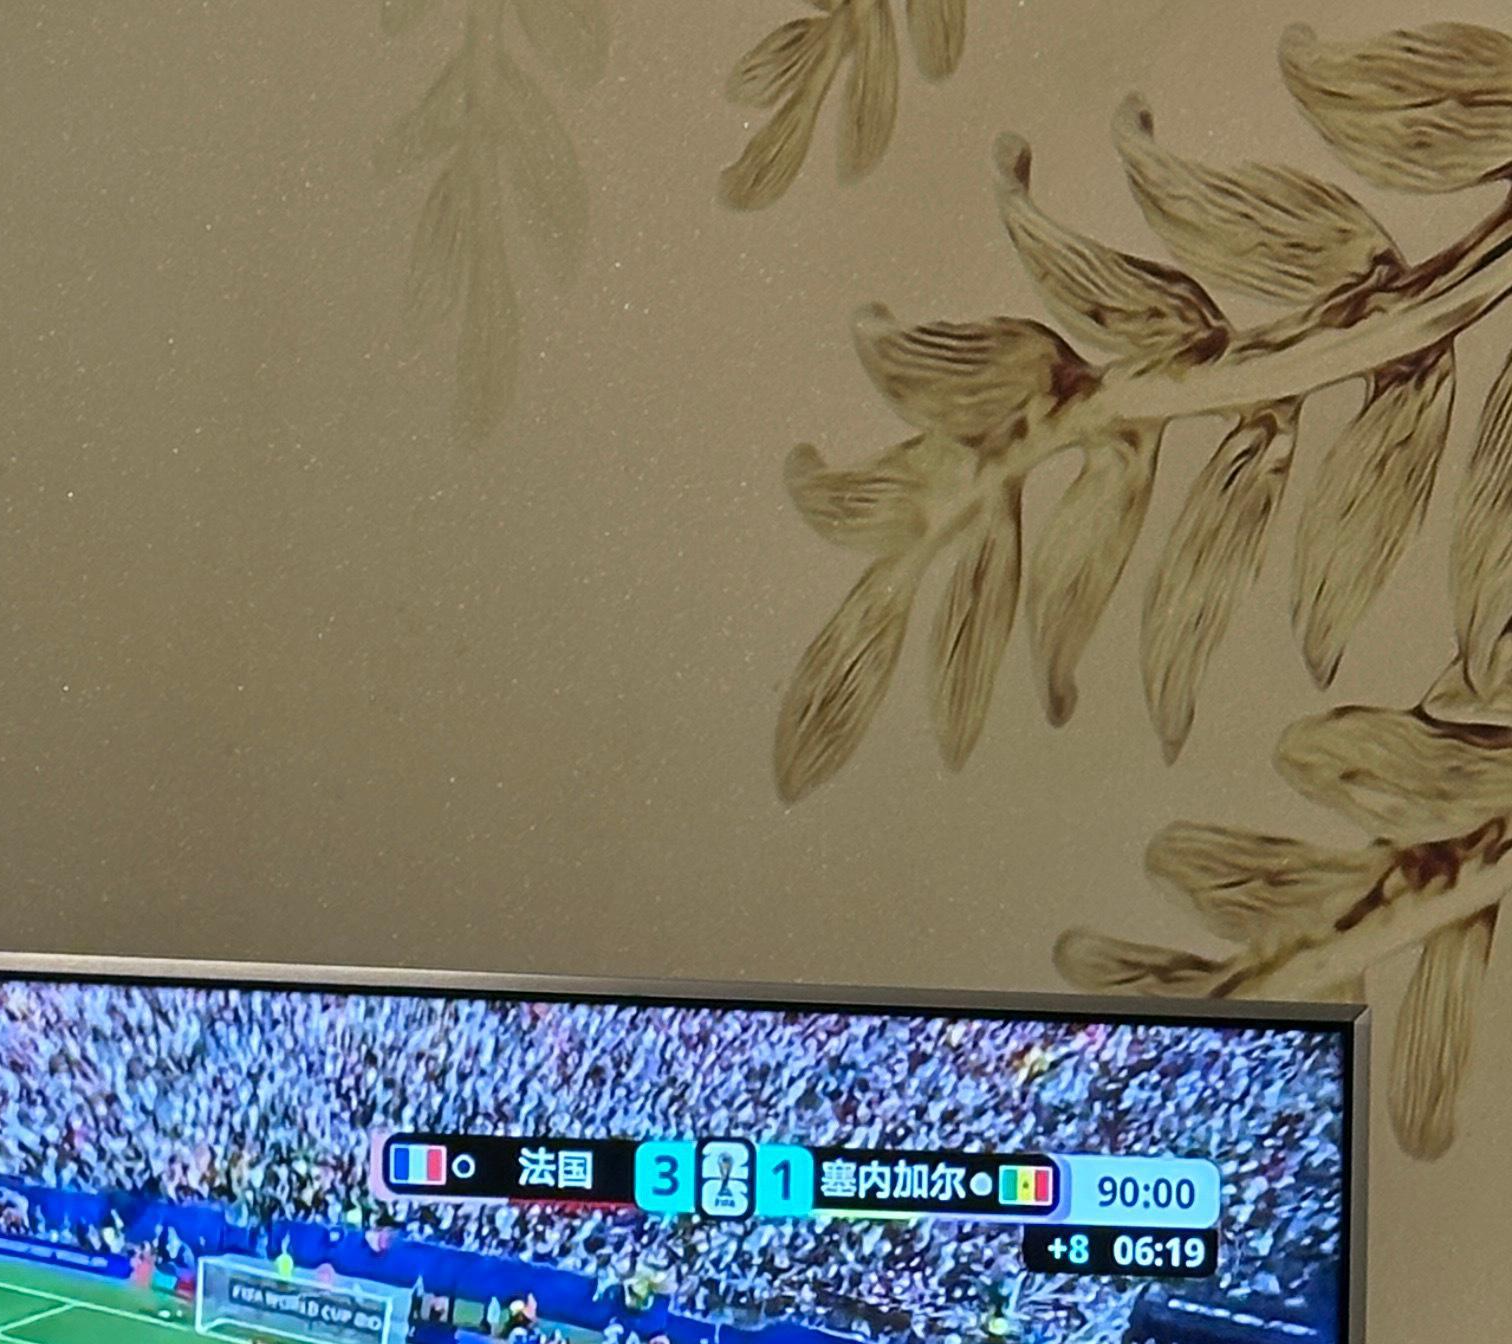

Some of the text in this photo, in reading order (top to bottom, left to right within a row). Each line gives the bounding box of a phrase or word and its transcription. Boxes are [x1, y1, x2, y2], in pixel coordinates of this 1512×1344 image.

[519, 1147, 594, 1190] 法国
[651, 1154, 679, 1197] 3
[771, 1159, 790, 1200] 1
[819, 1158, 966, 1200] 塞内加尔
[1097, 1176, 1196, 1210] 90:00
[1047, 1234, 1206, 1268] +8 06:19
